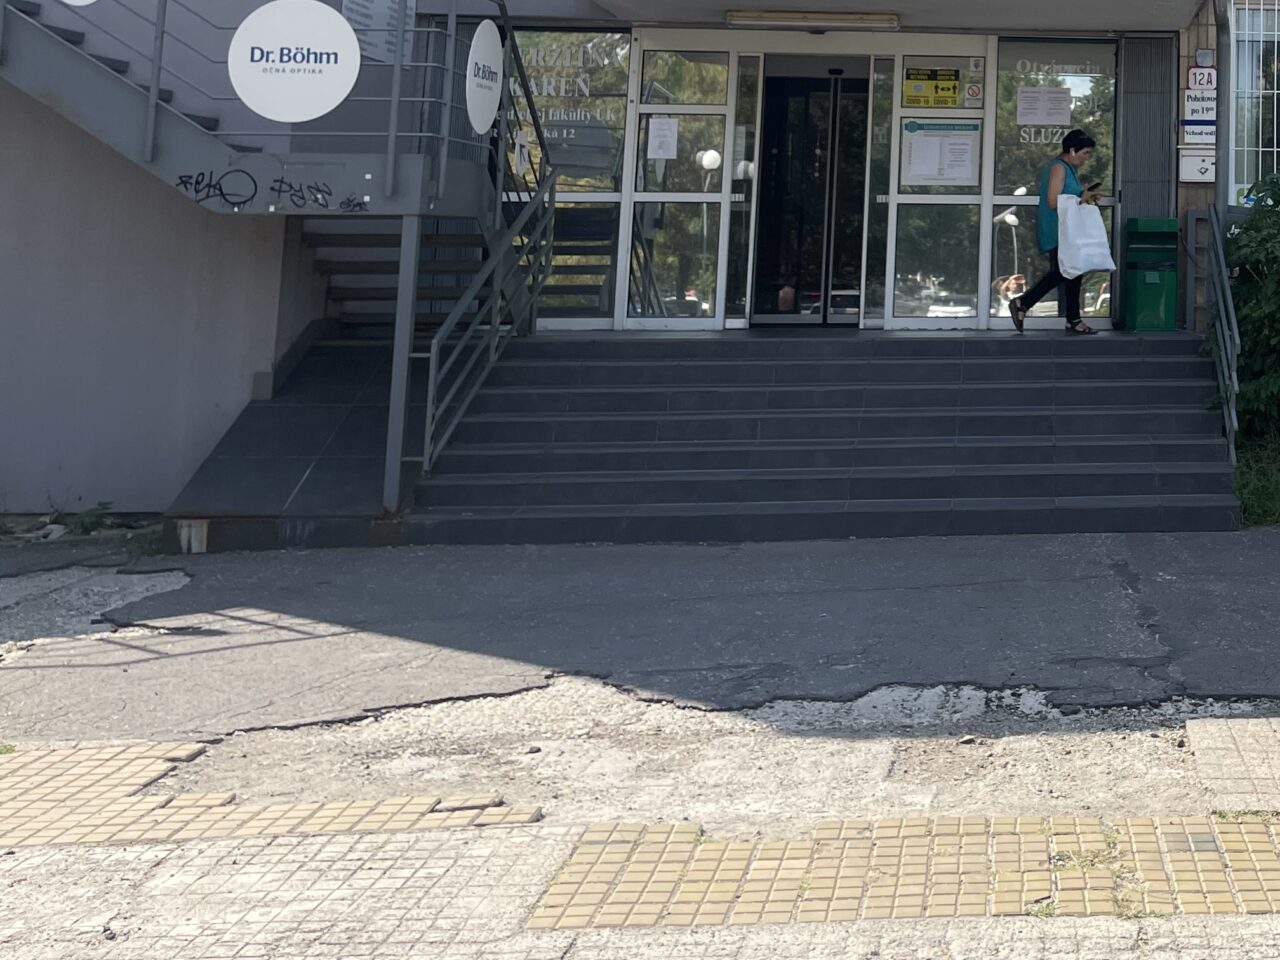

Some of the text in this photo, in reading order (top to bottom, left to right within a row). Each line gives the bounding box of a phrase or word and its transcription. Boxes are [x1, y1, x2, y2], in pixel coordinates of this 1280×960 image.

[250, 46, 339, 64] Dr. Böhm
[262, 66, 286, 74] OČNÁ
[473, 61, 499, 83] Dr. Böhm
[1192, 72, 1213, 87] 12A
[1186, 94, 1217, 103] Pohotovo
[549, 108, 592, 124] fakulty
[1191, 108, 1200, 116] po
[562, 128, 576, 138] 12
